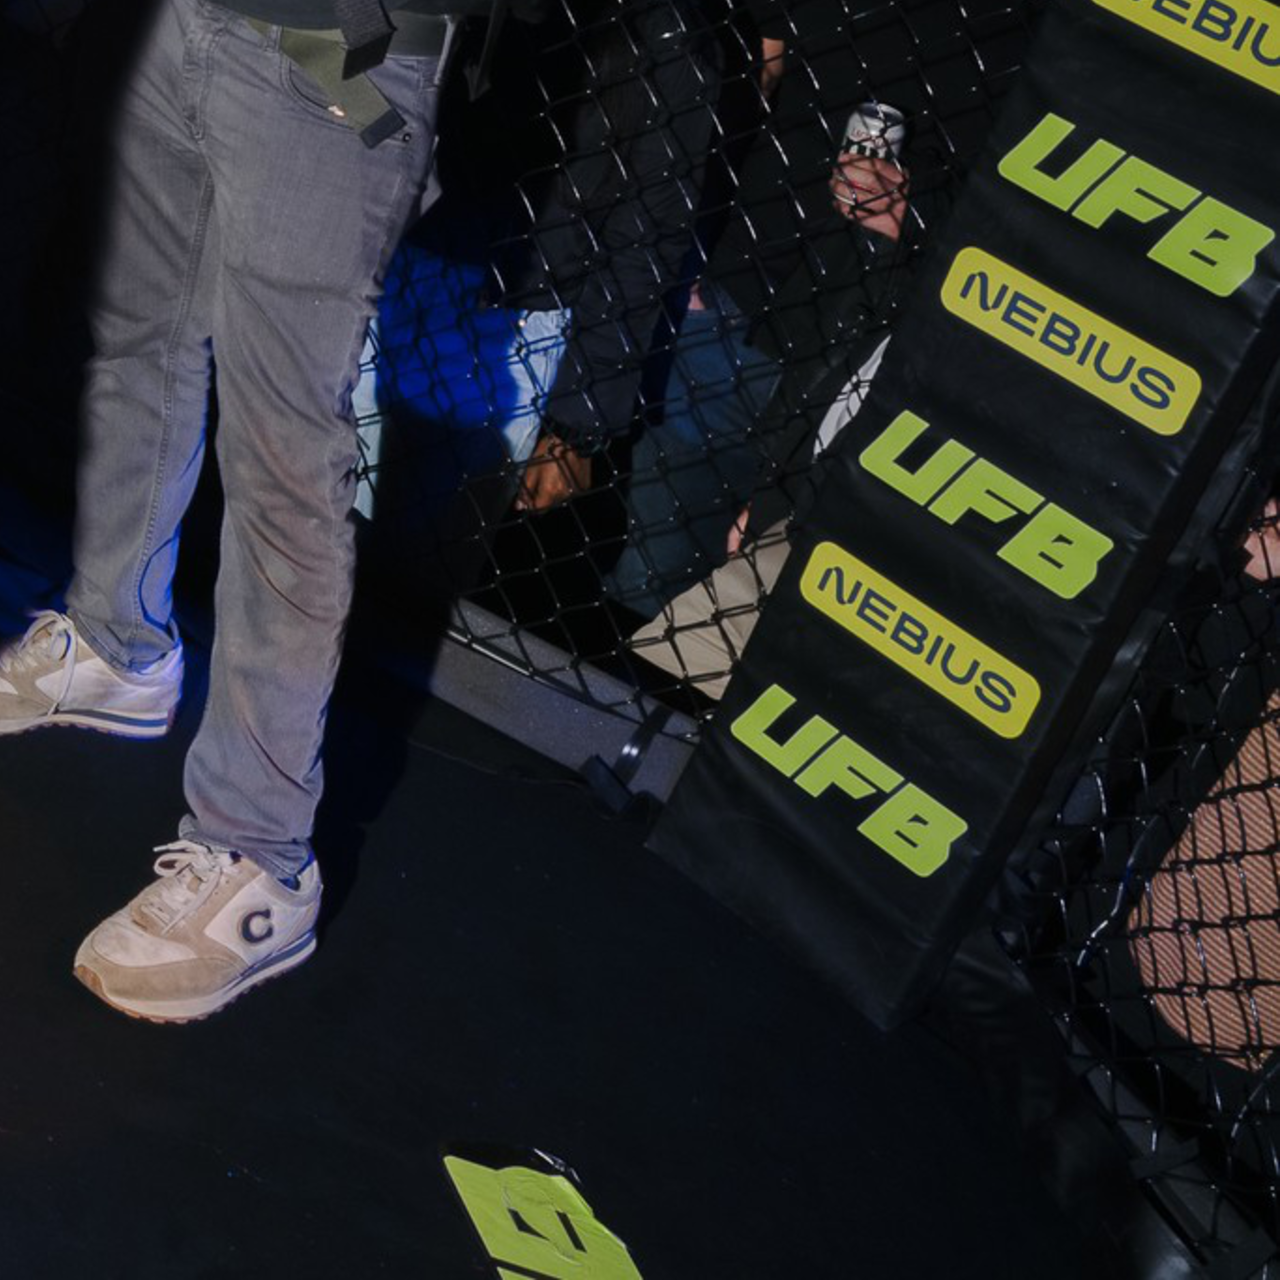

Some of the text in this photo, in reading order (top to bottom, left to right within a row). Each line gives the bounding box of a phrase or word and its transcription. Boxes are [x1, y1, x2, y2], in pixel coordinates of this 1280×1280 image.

[997, 111, 1275, 298] UFB
[960, 271, 1176, 412] NEBIUS
[858, 409, 1115, 601] UFB
[817, 566, 1017, 716] NEBIUS
[730, 682, 969, 879] UFB
